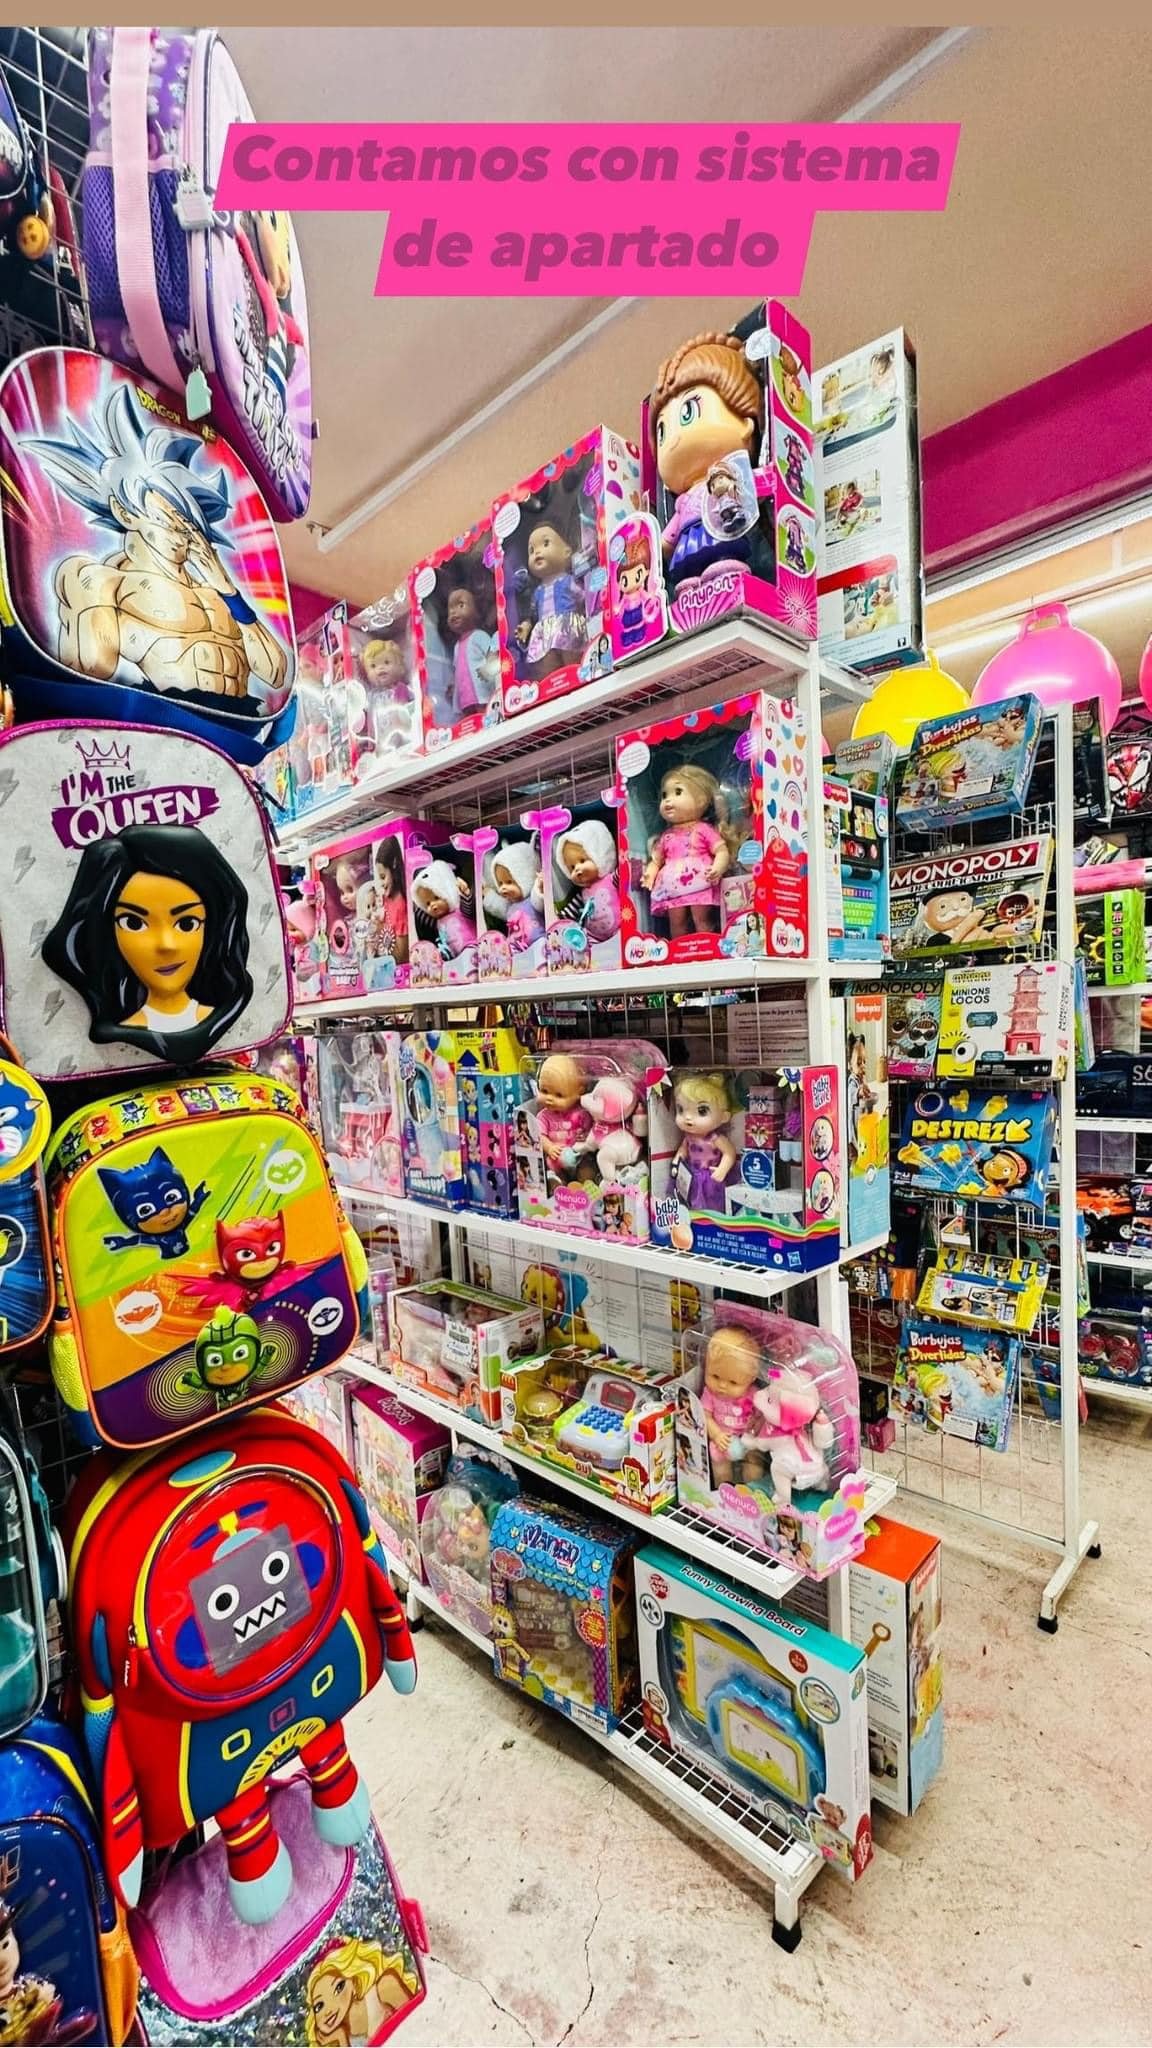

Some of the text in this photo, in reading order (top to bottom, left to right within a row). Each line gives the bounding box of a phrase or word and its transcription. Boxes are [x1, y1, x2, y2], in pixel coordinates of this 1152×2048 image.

[61, 770, 136, 806] I'M THE
[70, 788, 202, 846] QUEEN
[890, 847, 1037, 888] MONOPOLY
[856, 981, 940, 994] MONOPOLY
[951, 987, 991, 996] MINIONS
[951, 995, 990, 1005] LOCOS
[752, 1158, 761, 1169] 5
[655, 1198, 679, 1216] baby
[656, 1213, 680, 1228] alive
[910, 1330, 962, 1348] Burbujas
[909, 1347, 966, 1361] Divertidas
[722, 1488, 758, 1516] Nenuco
[681, 1565, 715, 1590] Funny
[715, 1584, 764, 1615] Drawing
[765, 1610, 807, 1636] Board
